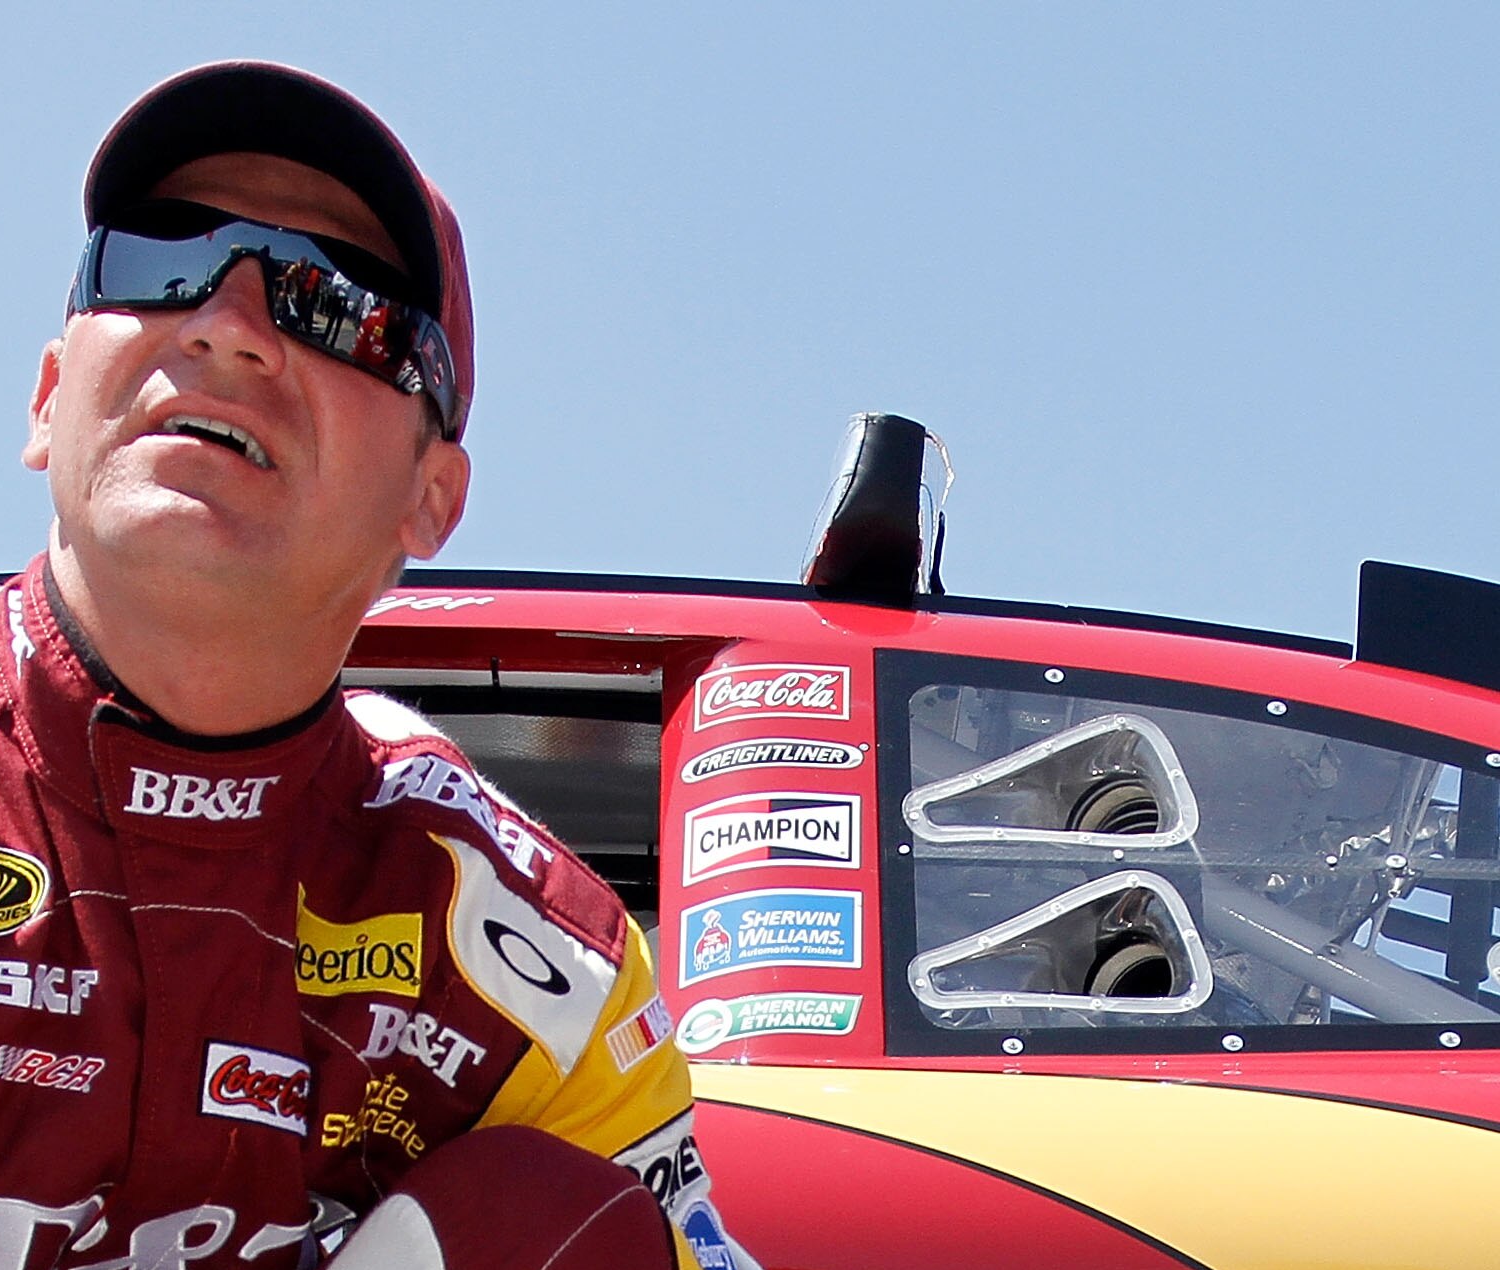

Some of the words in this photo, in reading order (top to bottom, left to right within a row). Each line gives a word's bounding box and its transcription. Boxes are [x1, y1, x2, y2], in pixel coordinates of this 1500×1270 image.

[702, 671, 840, 716] Coca-Cola
[696, 743, 845, 777] FREIGHTLINER
[123, 766, 282, 822] BB&T
[699, 818, 840, 854] CHAMPION
[739, 909, 841, 930] SHERWIN
[738, 944, 801, 959] Automotive
[802, 944, 844, 956] Finishes
[737, 999, 846, 1019] AMERICAN
[739, 1013, 837, 1032] ETHANOL
